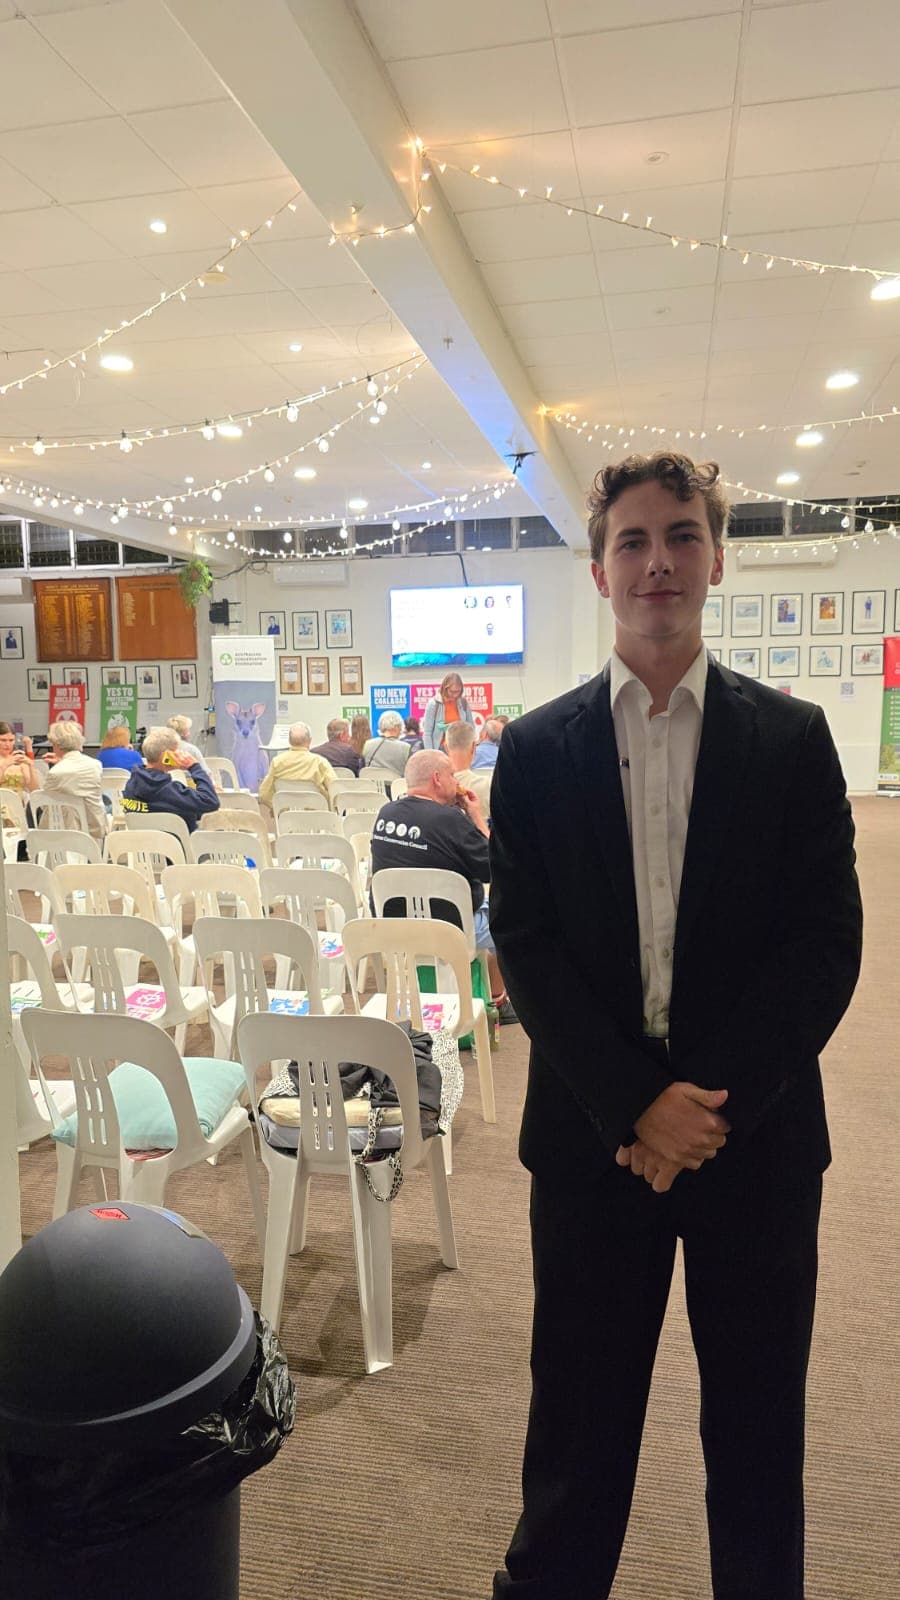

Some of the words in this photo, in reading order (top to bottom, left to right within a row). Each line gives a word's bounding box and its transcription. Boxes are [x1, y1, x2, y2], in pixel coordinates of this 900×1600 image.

[56, 688, 67, 697] NO
[69, 688, 79, 697] TO
[106, 687, 121, 697] YES
[123, 687, 133, 697] TO
[374, 688, 386, 697] NO
[387, 688, 407, 697] NEW
[416, 687, 434, 697] YES
[473, 687, 485, 697] TO
